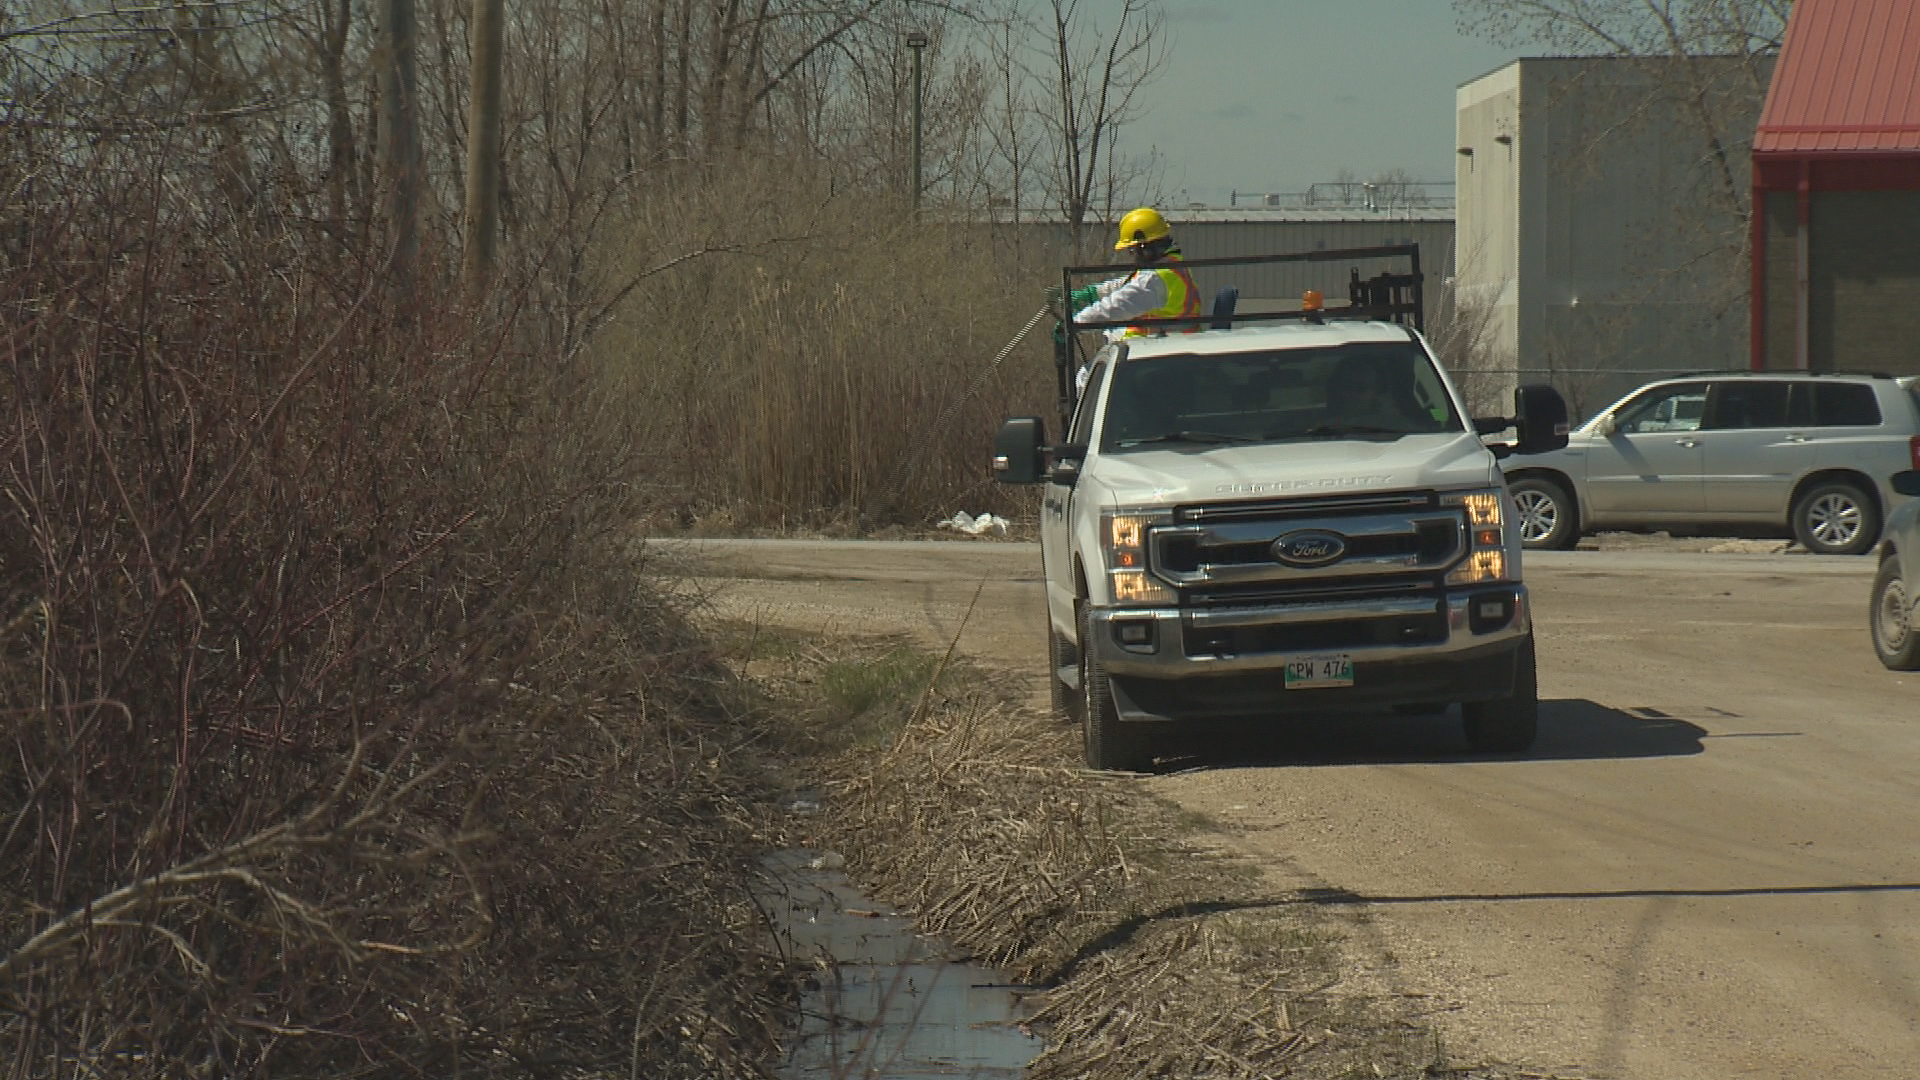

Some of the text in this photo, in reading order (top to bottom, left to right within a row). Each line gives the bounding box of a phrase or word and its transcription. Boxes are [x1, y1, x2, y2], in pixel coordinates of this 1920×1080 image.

[1292, 541, 1329, 556] Ford
[1288, 660, 1349, 679] CPW 476
